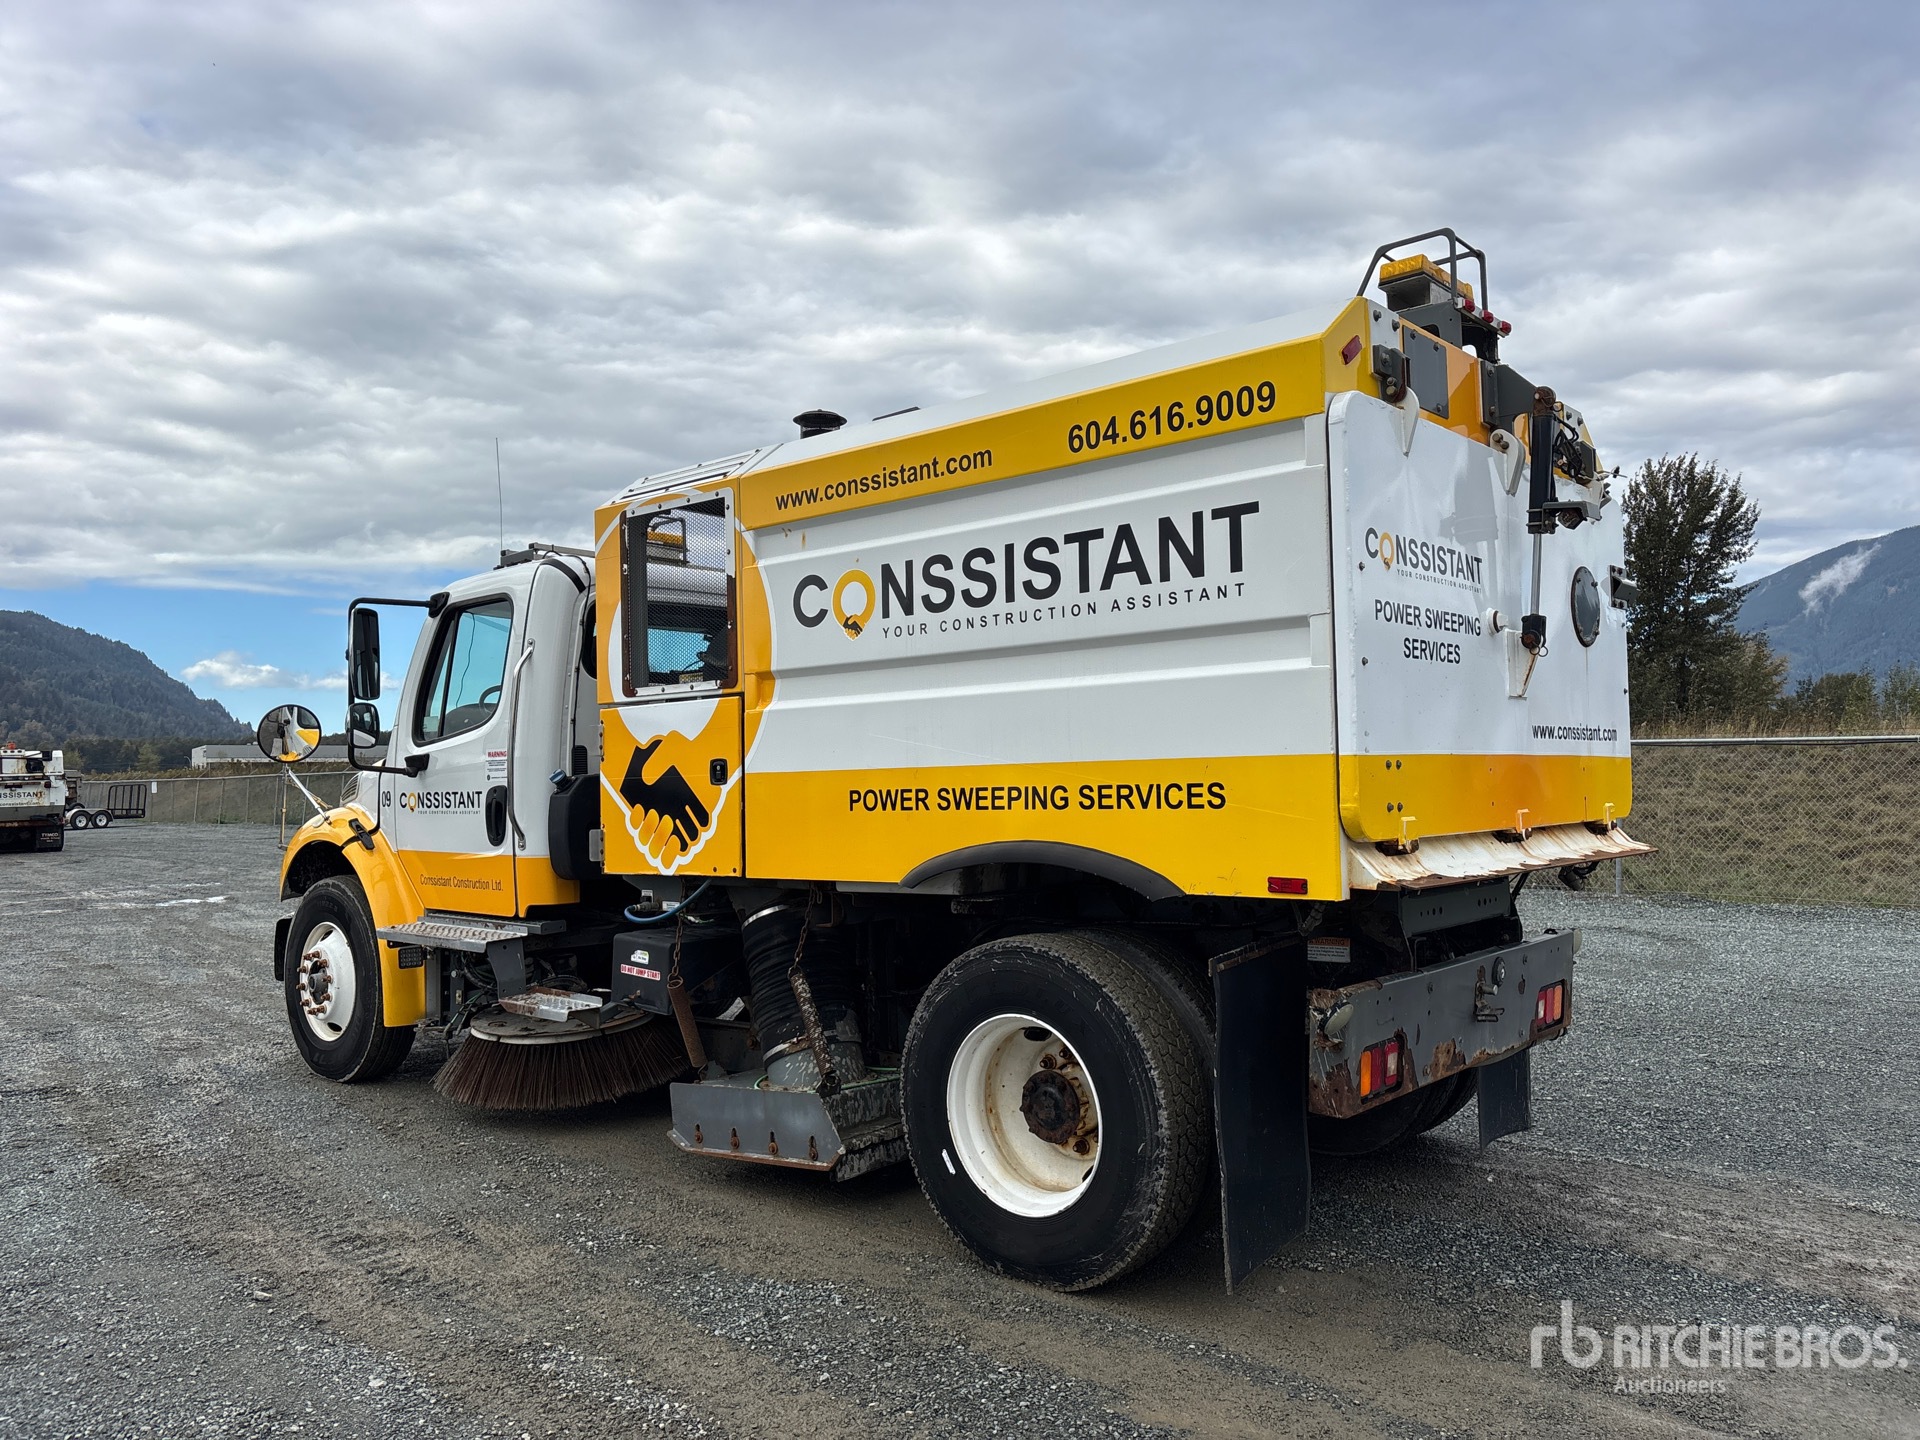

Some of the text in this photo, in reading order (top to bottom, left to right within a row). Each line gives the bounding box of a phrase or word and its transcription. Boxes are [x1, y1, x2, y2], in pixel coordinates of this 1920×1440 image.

[1067, 380, 1276, 454] 604.616.9009
[775, 449, 993, 511] www.conssistant.com
[1365, 527, 1482, 584] CONSSISTANT
[792, 501, 1260, 640] CONSSISTANT
[1397, 568, 1412, 578] YOUR
[1415, 572, 1457, 588] CONSTRUCTION
[882, 582, 1246, 639] YOUR CONSTRUCTION ASSISTANT
[1375, 599, 1481, 637] POWER SWEEPING
[1403, 637, 1461, 664] SERVICES
[1532, 723, 1617, 741] www.conssistant.com
[381, 790, 391, 808] 09
[399, 790, 482, 813] CONSSISTANT
[849, 782, 1227, 812] POWER SWEEPING SERVICES
[420, 873, 504, 891] Conssistant Construction Ltd.
[646, 970, 660, 979] START
